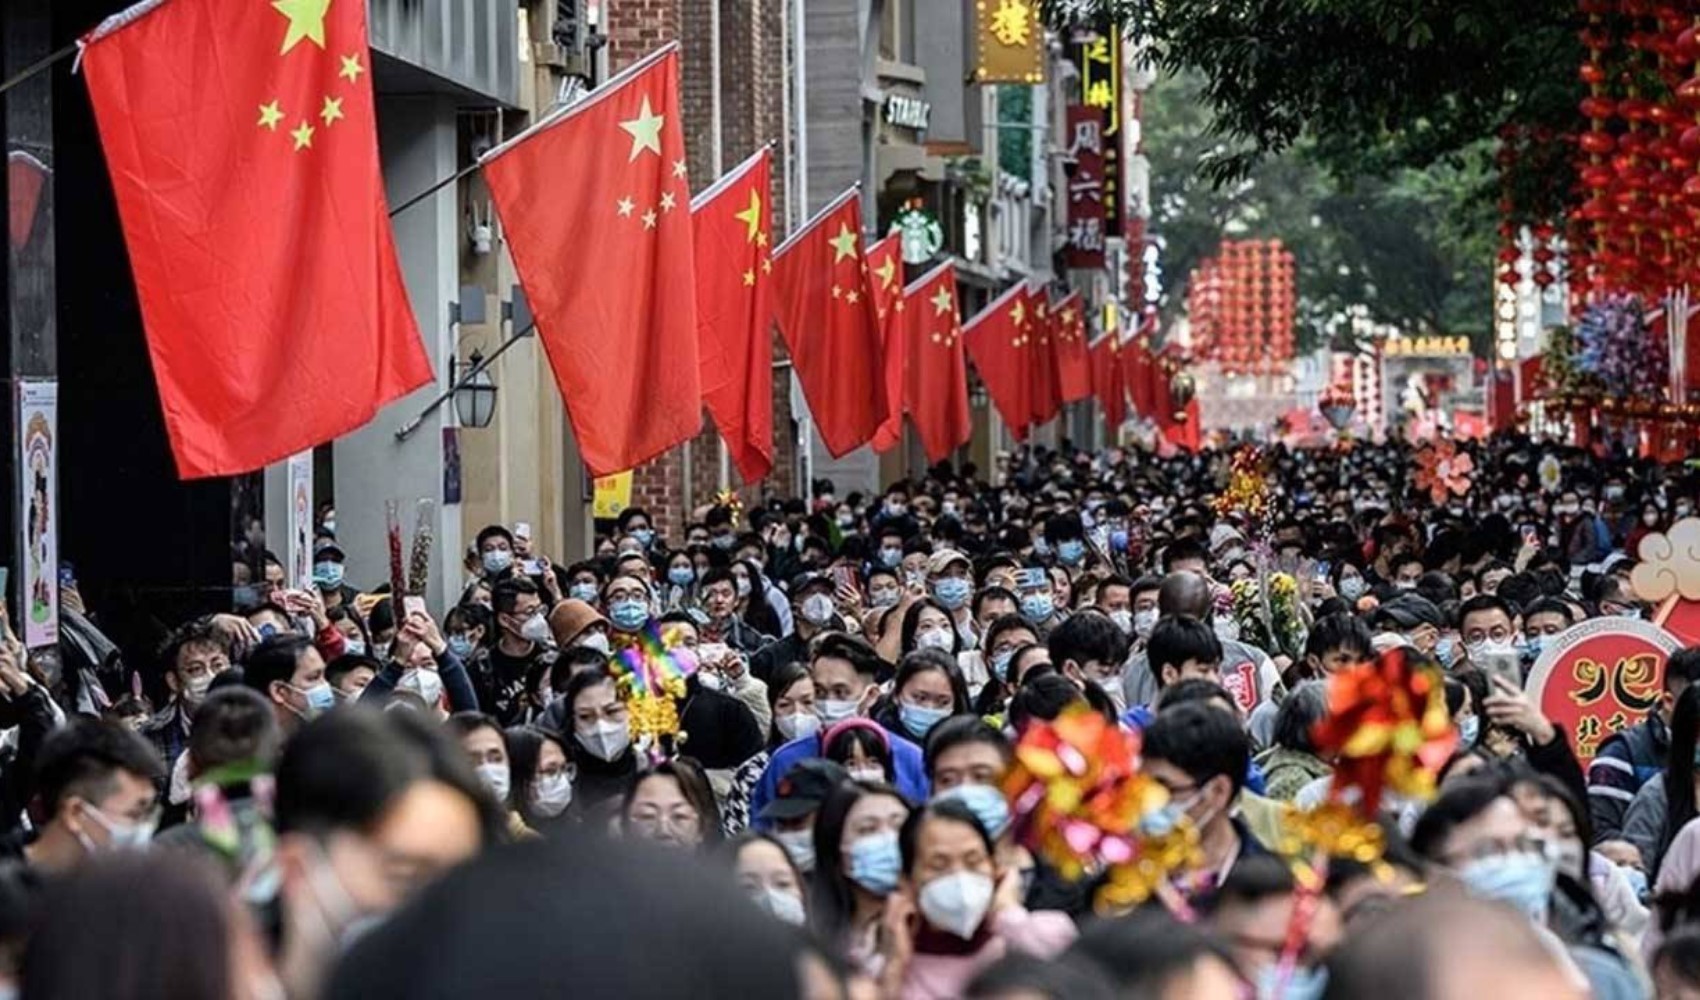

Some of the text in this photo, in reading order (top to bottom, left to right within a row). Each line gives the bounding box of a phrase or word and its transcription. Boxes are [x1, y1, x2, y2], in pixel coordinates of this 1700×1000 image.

[1069, 120, 1102, 250] 周六福
[1576, 711, 1648, 743] 北京
